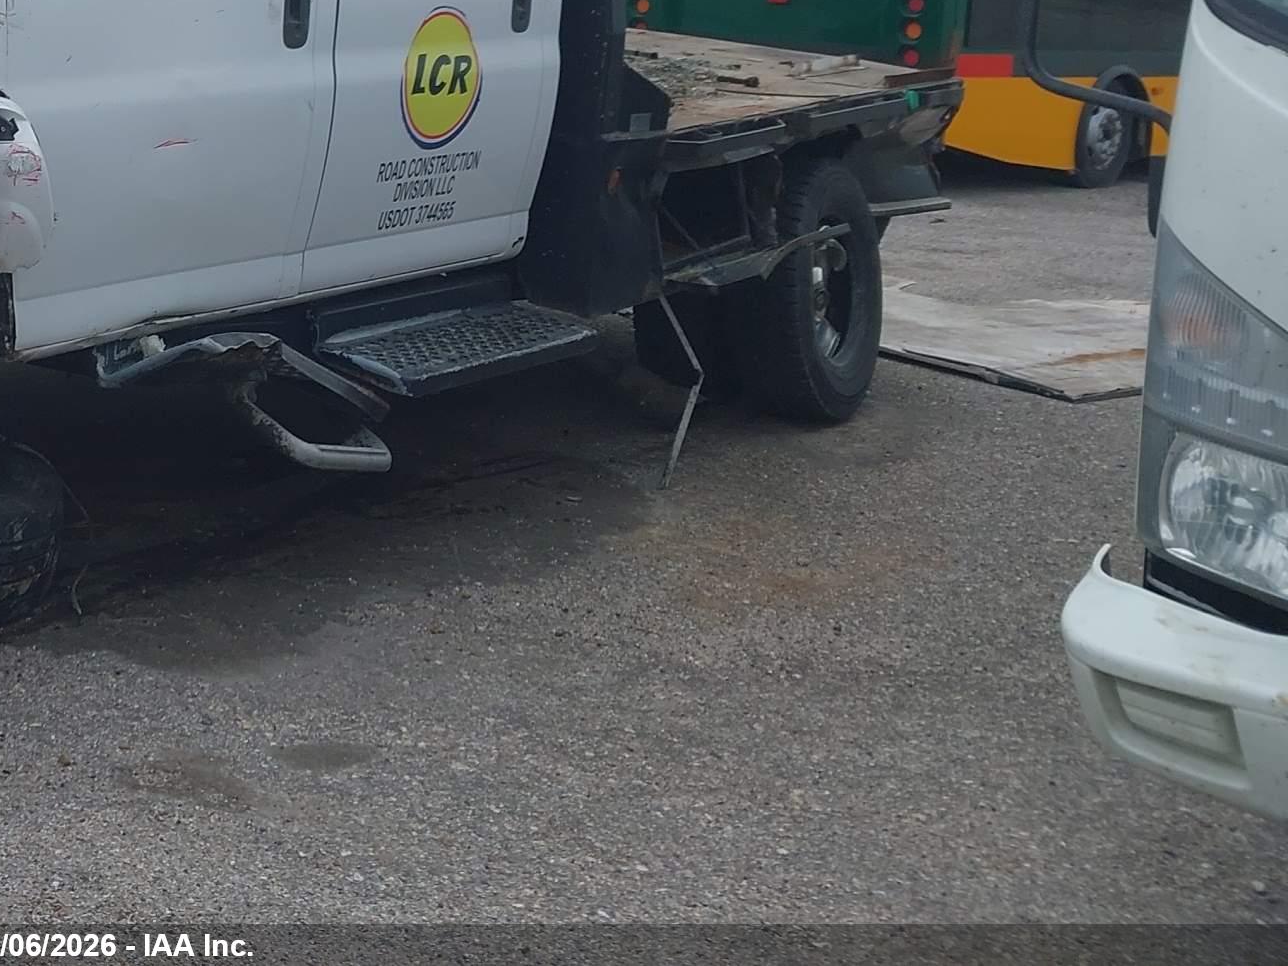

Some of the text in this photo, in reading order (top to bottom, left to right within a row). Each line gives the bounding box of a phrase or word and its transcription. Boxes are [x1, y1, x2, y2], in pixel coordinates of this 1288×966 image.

[410, 53, 473, 96] LCR
[376, 151, 481, 183] ROAD CONSTRUCTION
[393, 175, 456, 202] DIVISION LLC
[377, 206, 417, 230] USDOT
